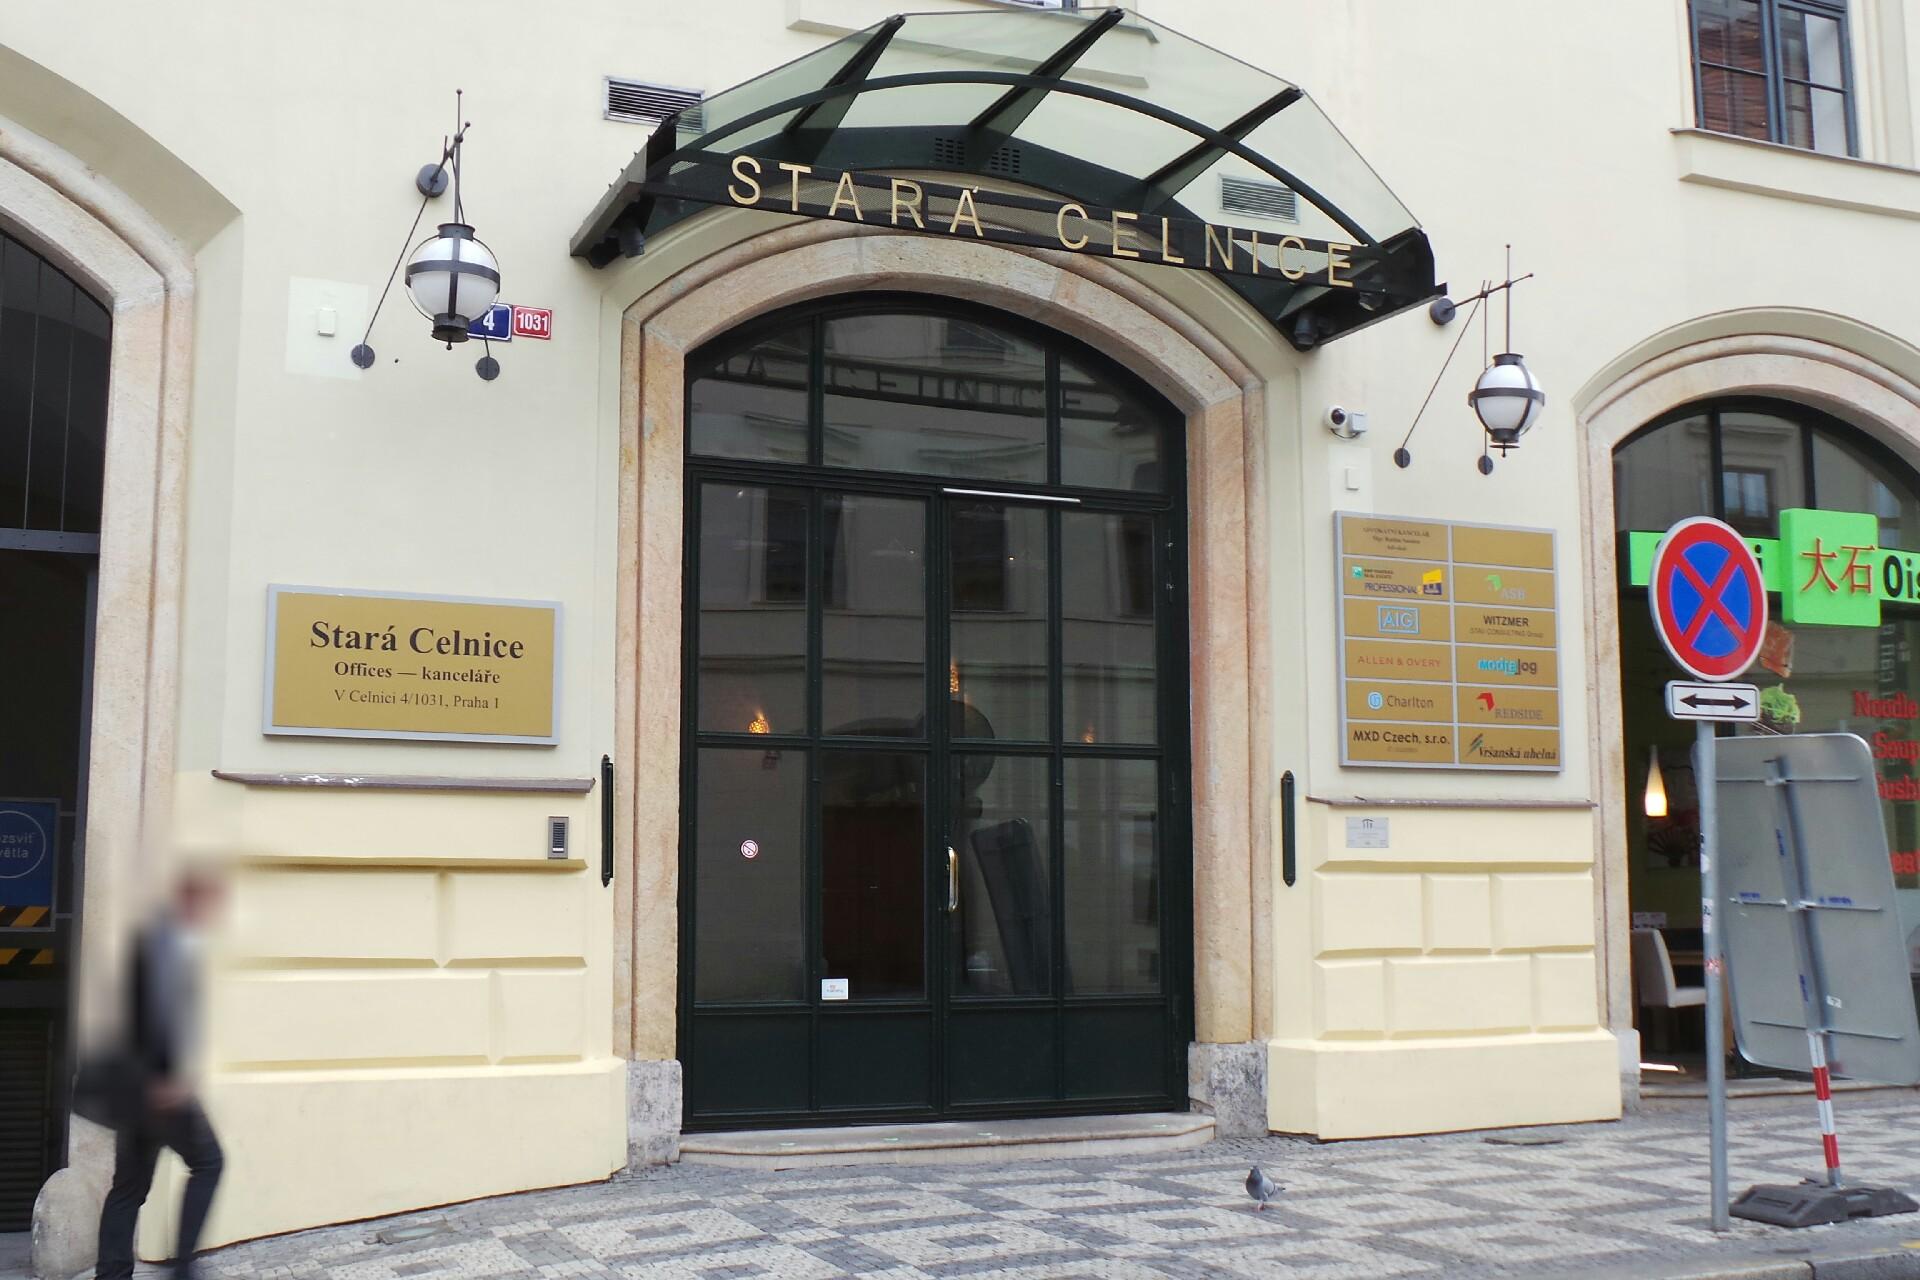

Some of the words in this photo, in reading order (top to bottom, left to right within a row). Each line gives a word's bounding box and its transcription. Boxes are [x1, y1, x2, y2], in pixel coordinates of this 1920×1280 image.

[727, 154, 984, 238] STARÁ
[1056, 203, 1354, 288] CELNICE
[483, 310, 495, 331] 4
[517, 313, 548, 332] 1031
[1800, 537, 1876, 595] 大石
[1883, 554, 1920, 600] Oi
[1382, 610, 1415, 628] AIG
[1483, 615, 1529, 627] WITZMER
[310, 620, 398, 652] Stará
[409, 626, 525, 659] Celnice
[1357, 655, 1394, 666] ALLEN
[1396, 657, 1404, 666] &
[1406, 657, 1441, 668] OVERY
[334, 661, 393, 679] Offices
[421, 666, 501, 684] kanceláře
[334, 689, 346, 702] V
[349, 689, 397, 705] Celnici
[400, 692, 450, 709] 4/1031,
[453, 696, 490, 710] Praha
[494, 697, 500, 710] 1
[1386, 695, 1434, 709] Charlton
[1853, 689, 1919, 719] Noodle
[1353, 730, 1380, 743] MXD
[1425, 735, 1451, 745] s.r.o.
[1872, 731, 1920, 766] Soup
